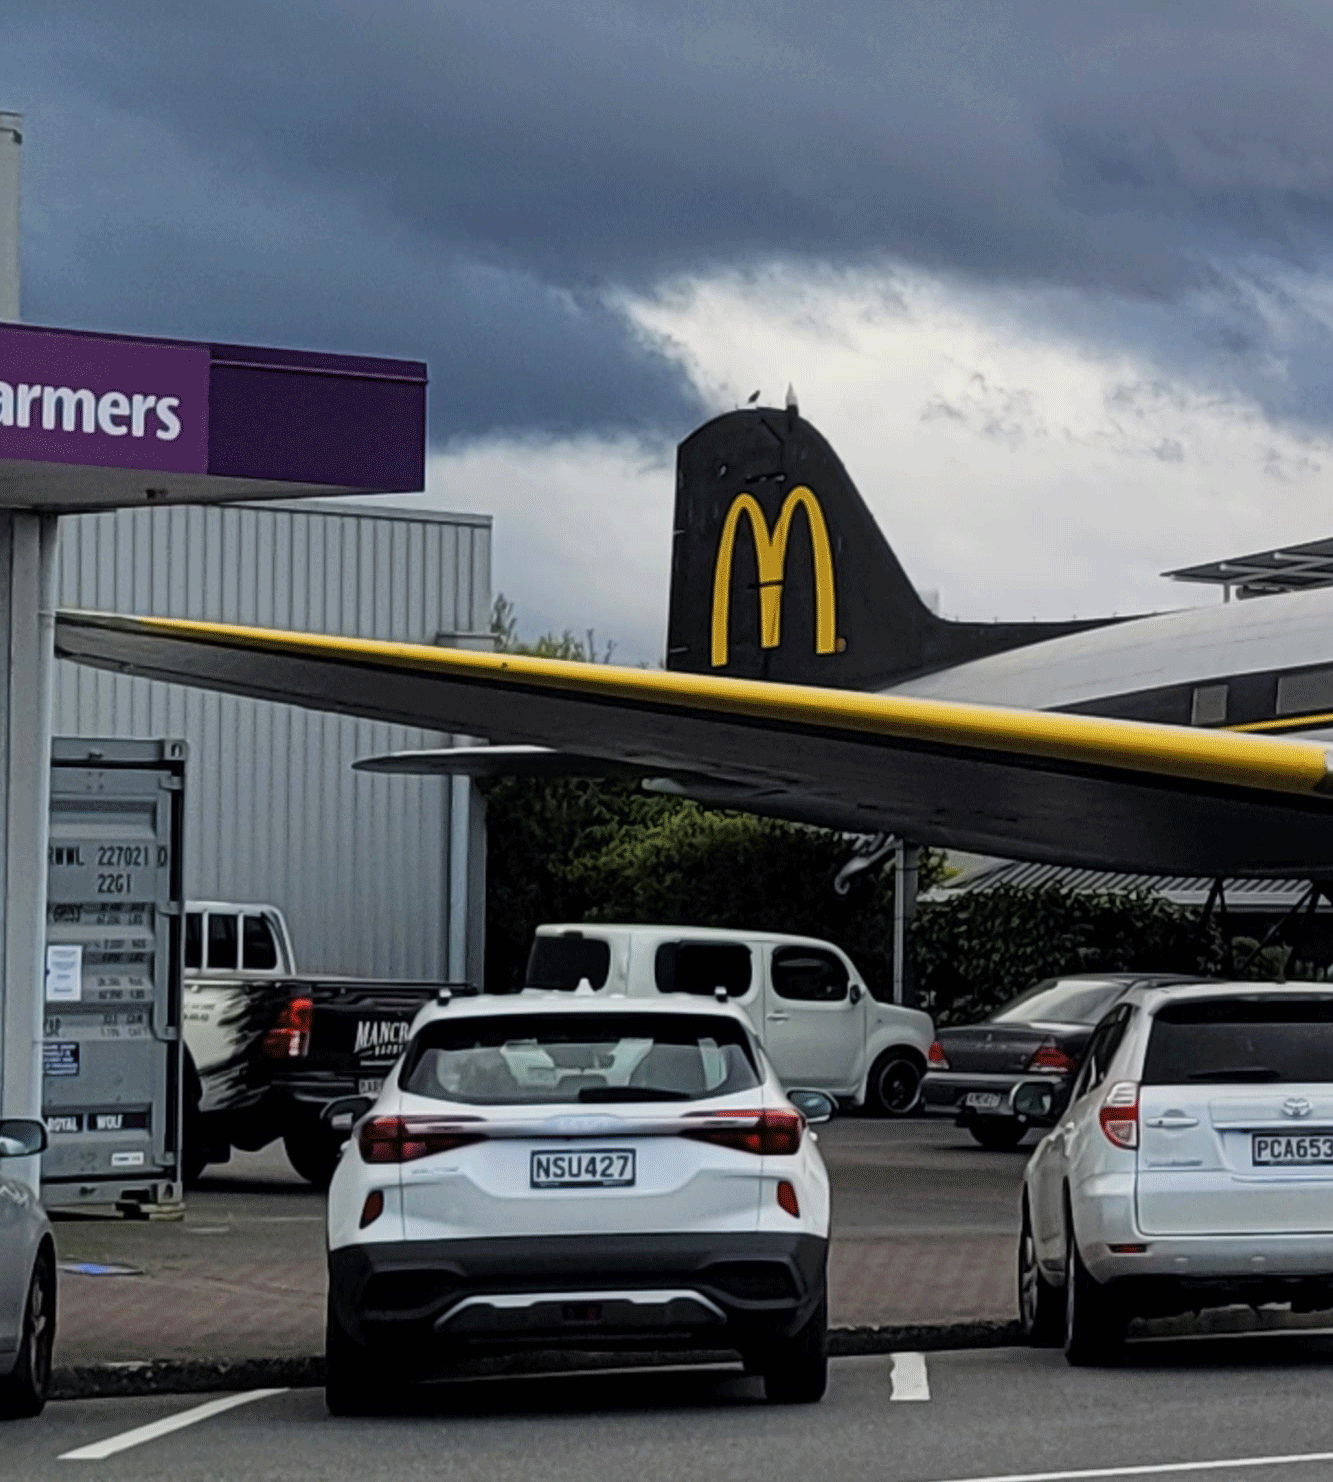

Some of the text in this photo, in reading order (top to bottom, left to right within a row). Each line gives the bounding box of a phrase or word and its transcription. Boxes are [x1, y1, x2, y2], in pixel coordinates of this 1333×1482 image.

[97, 846, 149, 866] 227021
[97, 874, 132, 893] 22G1
[97, 1115, 124, 1129] WOLF
[1257, 1139, 1333, 1159] PCA653
[536, 1155, 630, 1178] NSU427
